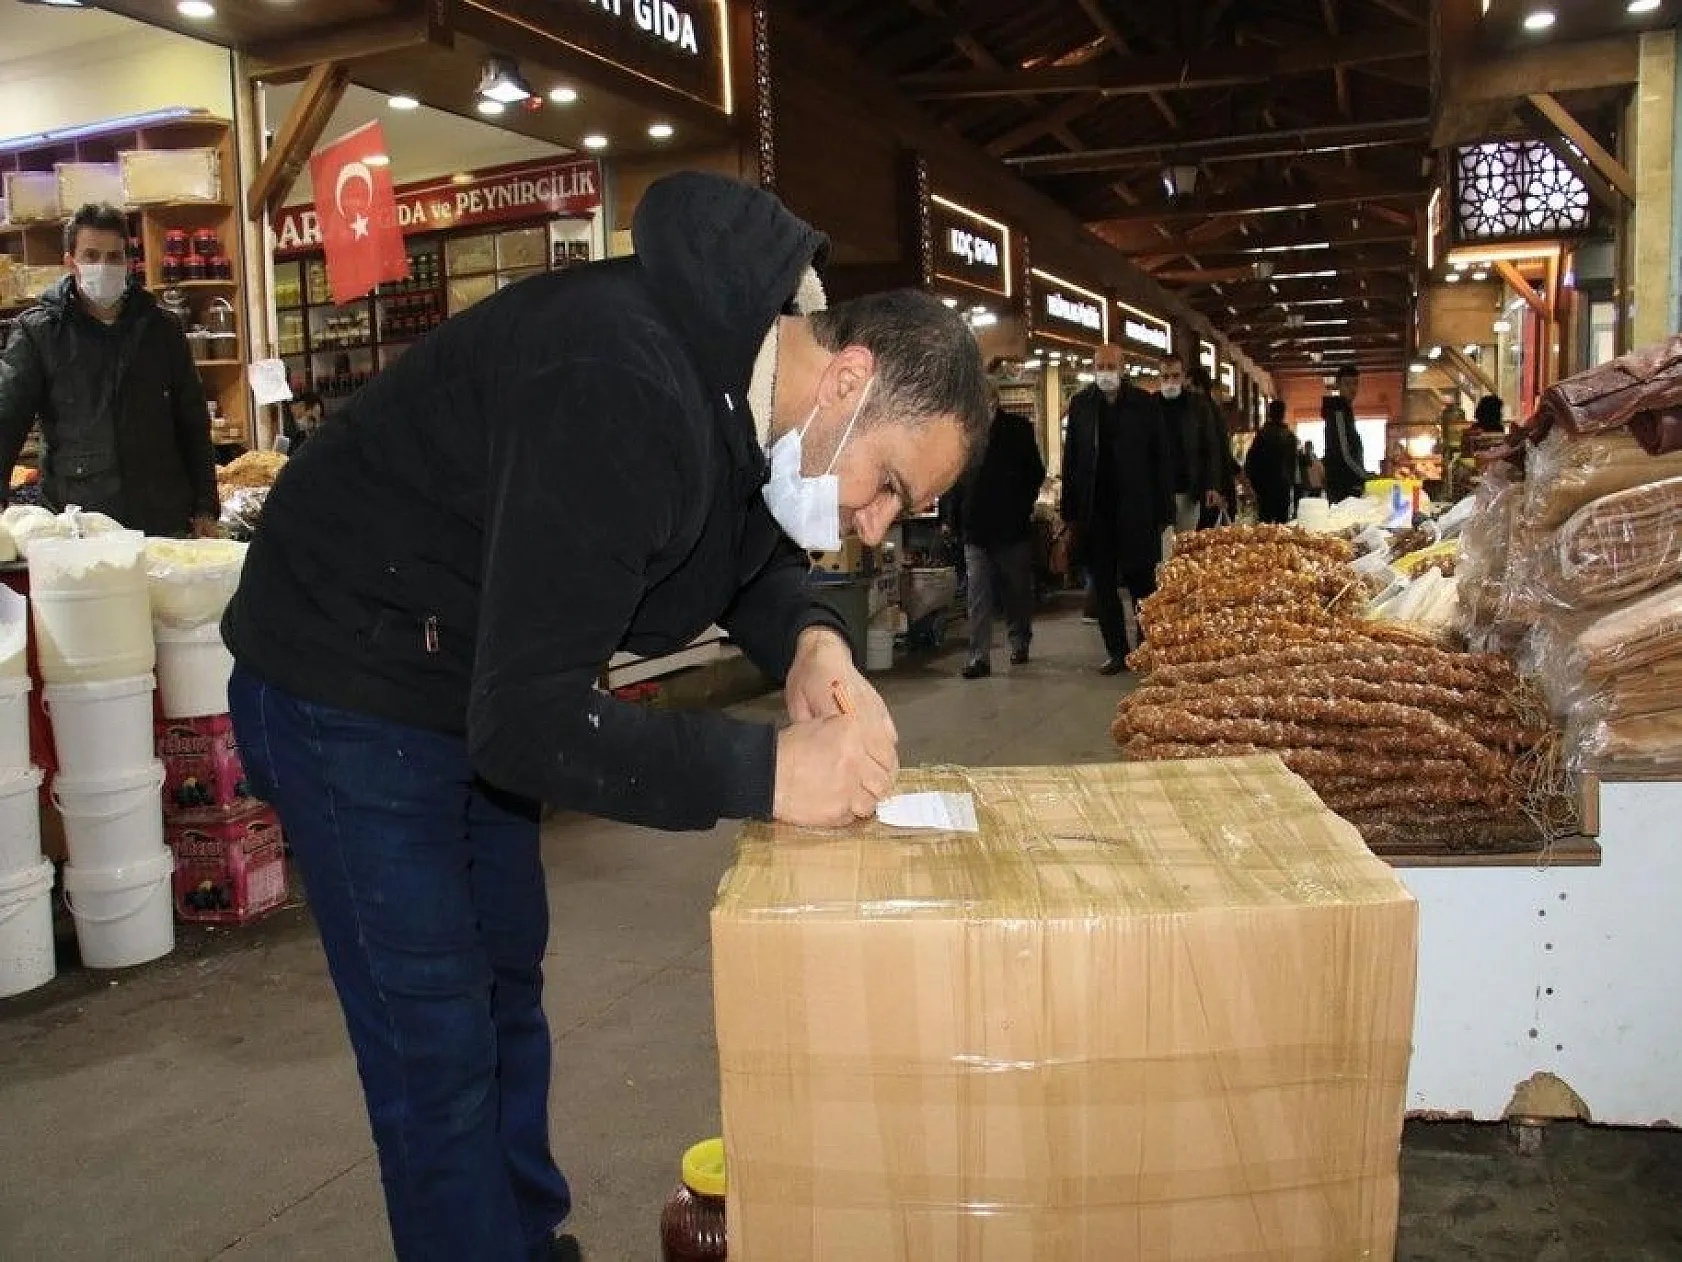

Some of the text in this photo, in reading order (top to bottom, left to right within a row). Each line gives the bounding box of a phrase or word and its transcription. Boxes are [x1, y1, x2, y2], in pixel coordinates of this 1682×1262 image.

[633, 0, 698, 54] GIDA
[268, 211, 322, 249] AR
[397, 202, 427, 227] DA
[431, 199, 452, 219] ve
